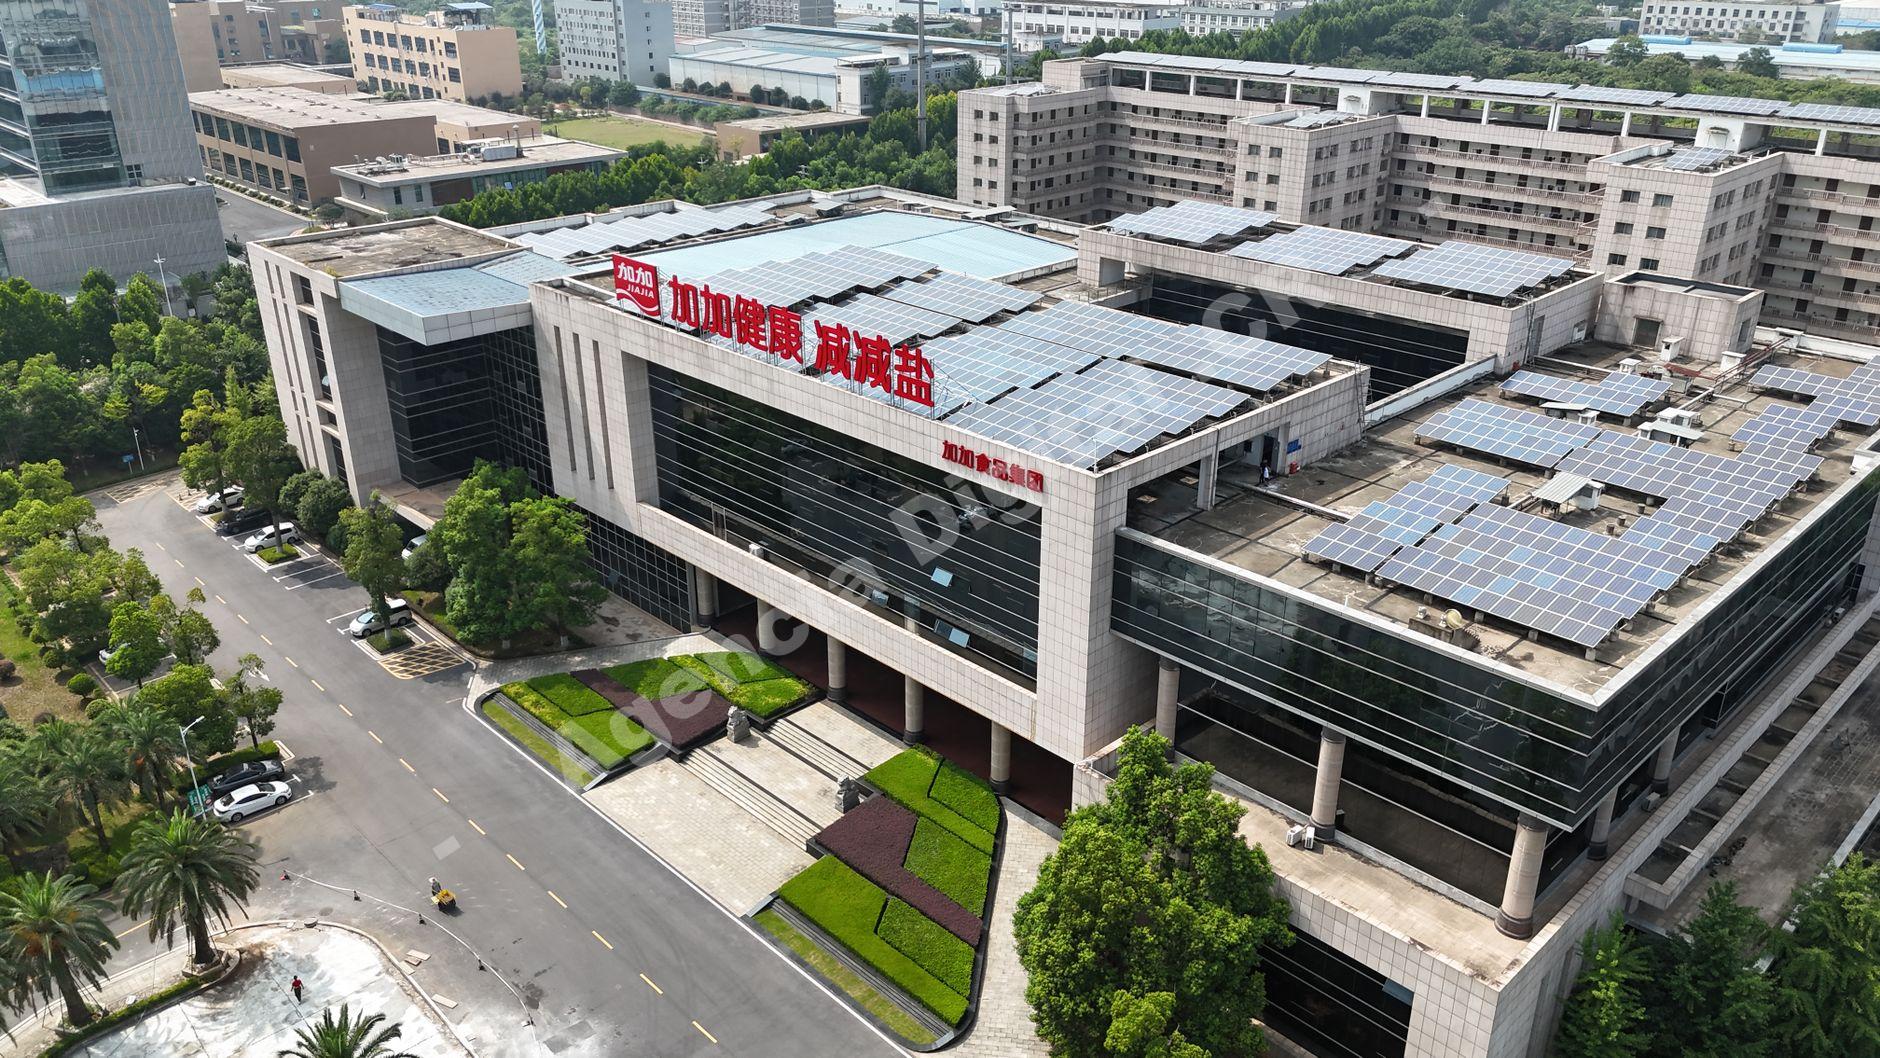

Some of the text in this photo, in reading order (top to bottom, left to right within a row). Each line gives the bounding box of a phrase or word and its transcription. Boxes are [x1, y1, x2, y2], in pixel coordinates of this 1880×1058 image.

[617, 262, 654, 288] 加加
[626, 284, 655, 299] JIAJIA
[668, 276, 934, 407] 加加健康 减减盐
[942, 441, 1043, 492] 加加食品集团
